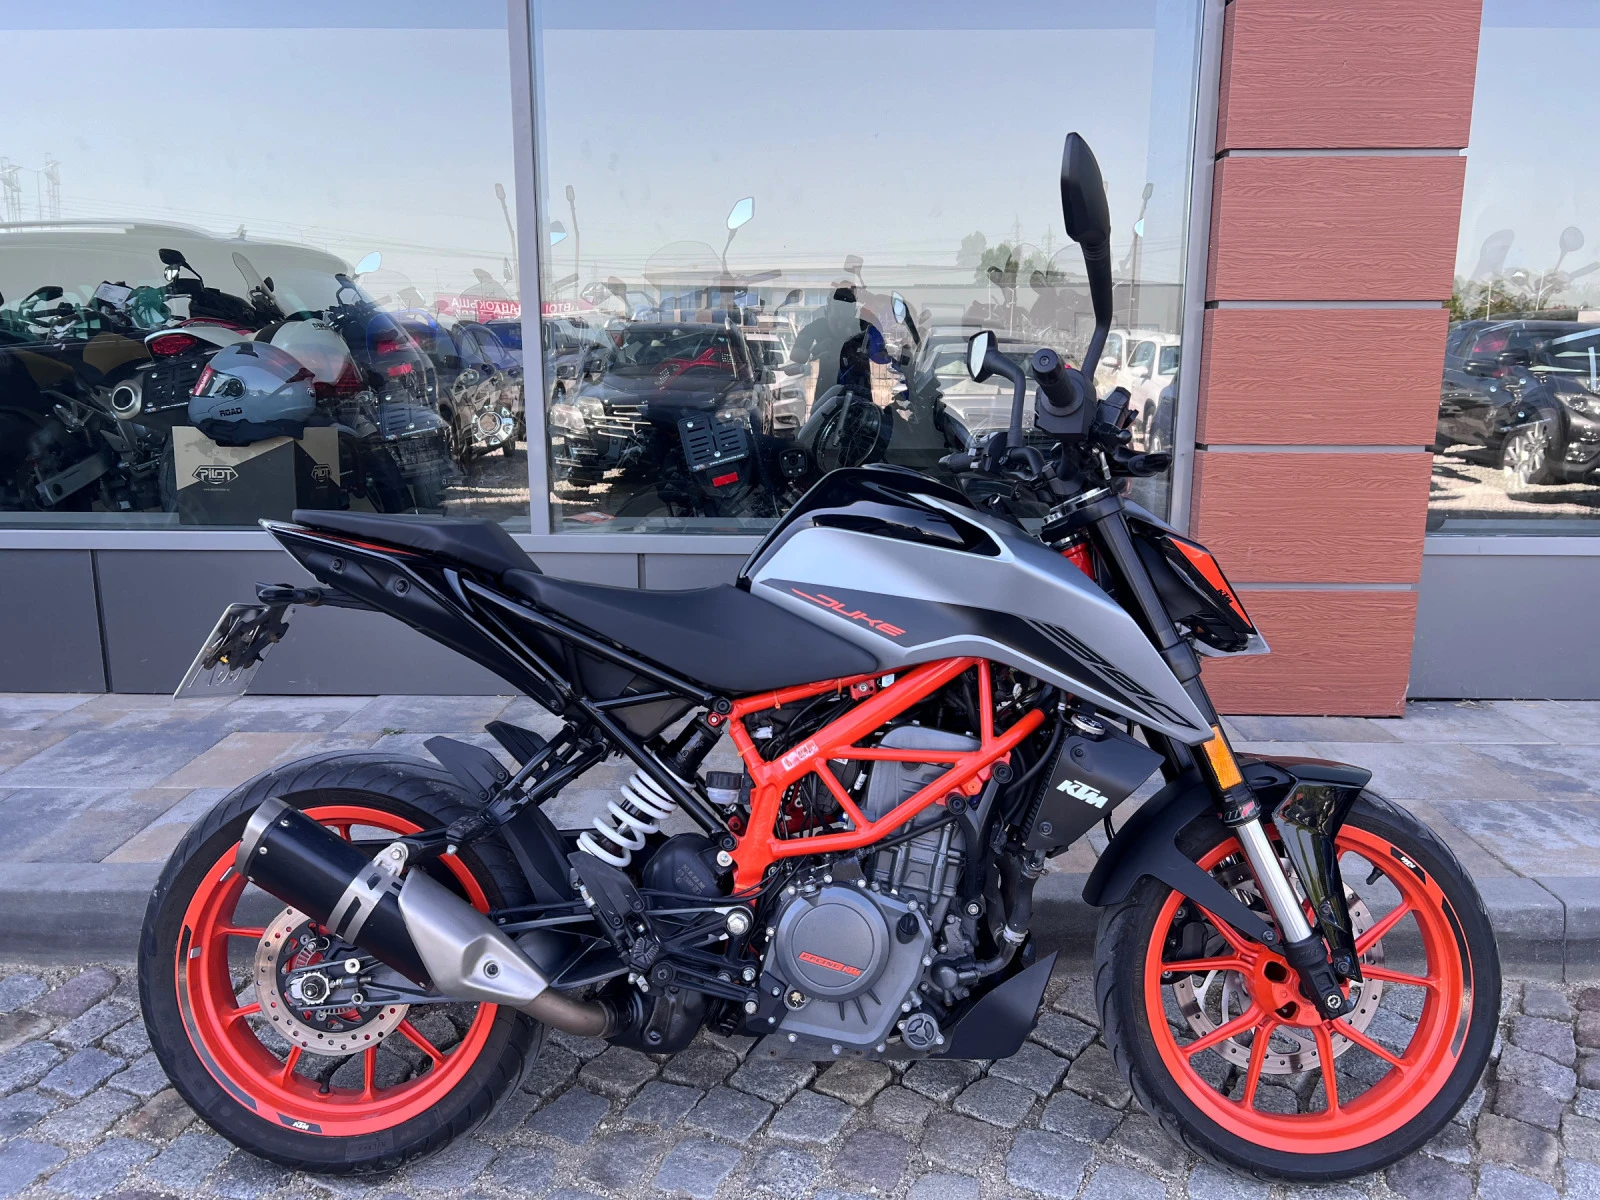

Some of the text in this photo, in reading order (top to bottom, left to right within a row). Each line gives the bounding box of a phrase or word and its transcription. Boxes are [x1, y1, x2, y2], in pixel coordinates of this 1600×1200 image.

[219, 407, 243, 417] ROAD
[791, 587, 907, 637] DUKE
[1056, 779, 1109, 809] KTM
[291, 1121, 310, 1131] KTM
